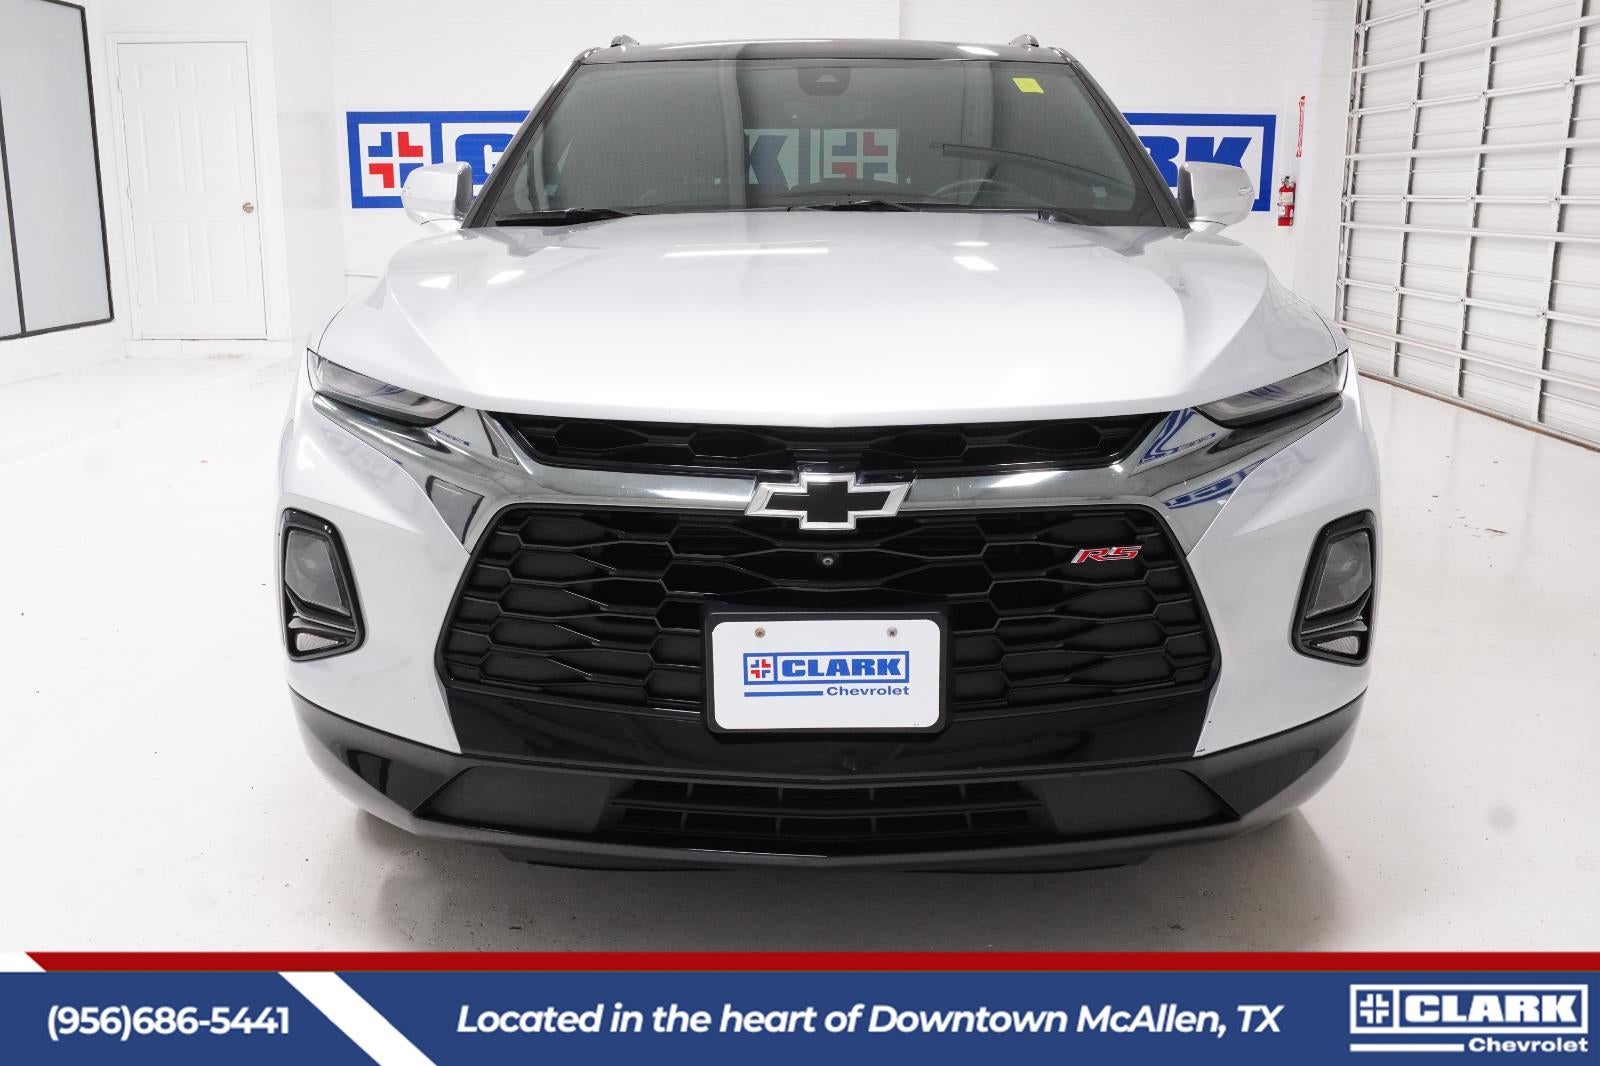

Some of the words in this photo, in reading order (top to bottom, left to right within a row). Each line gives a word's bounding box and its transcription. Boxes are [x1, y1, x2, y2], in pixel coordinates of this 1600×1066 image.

[1071, 545, 1142, 564] RS
[781, 658, 902, 677] CLARK
[826, 685, 909, 696] Chevrolet
